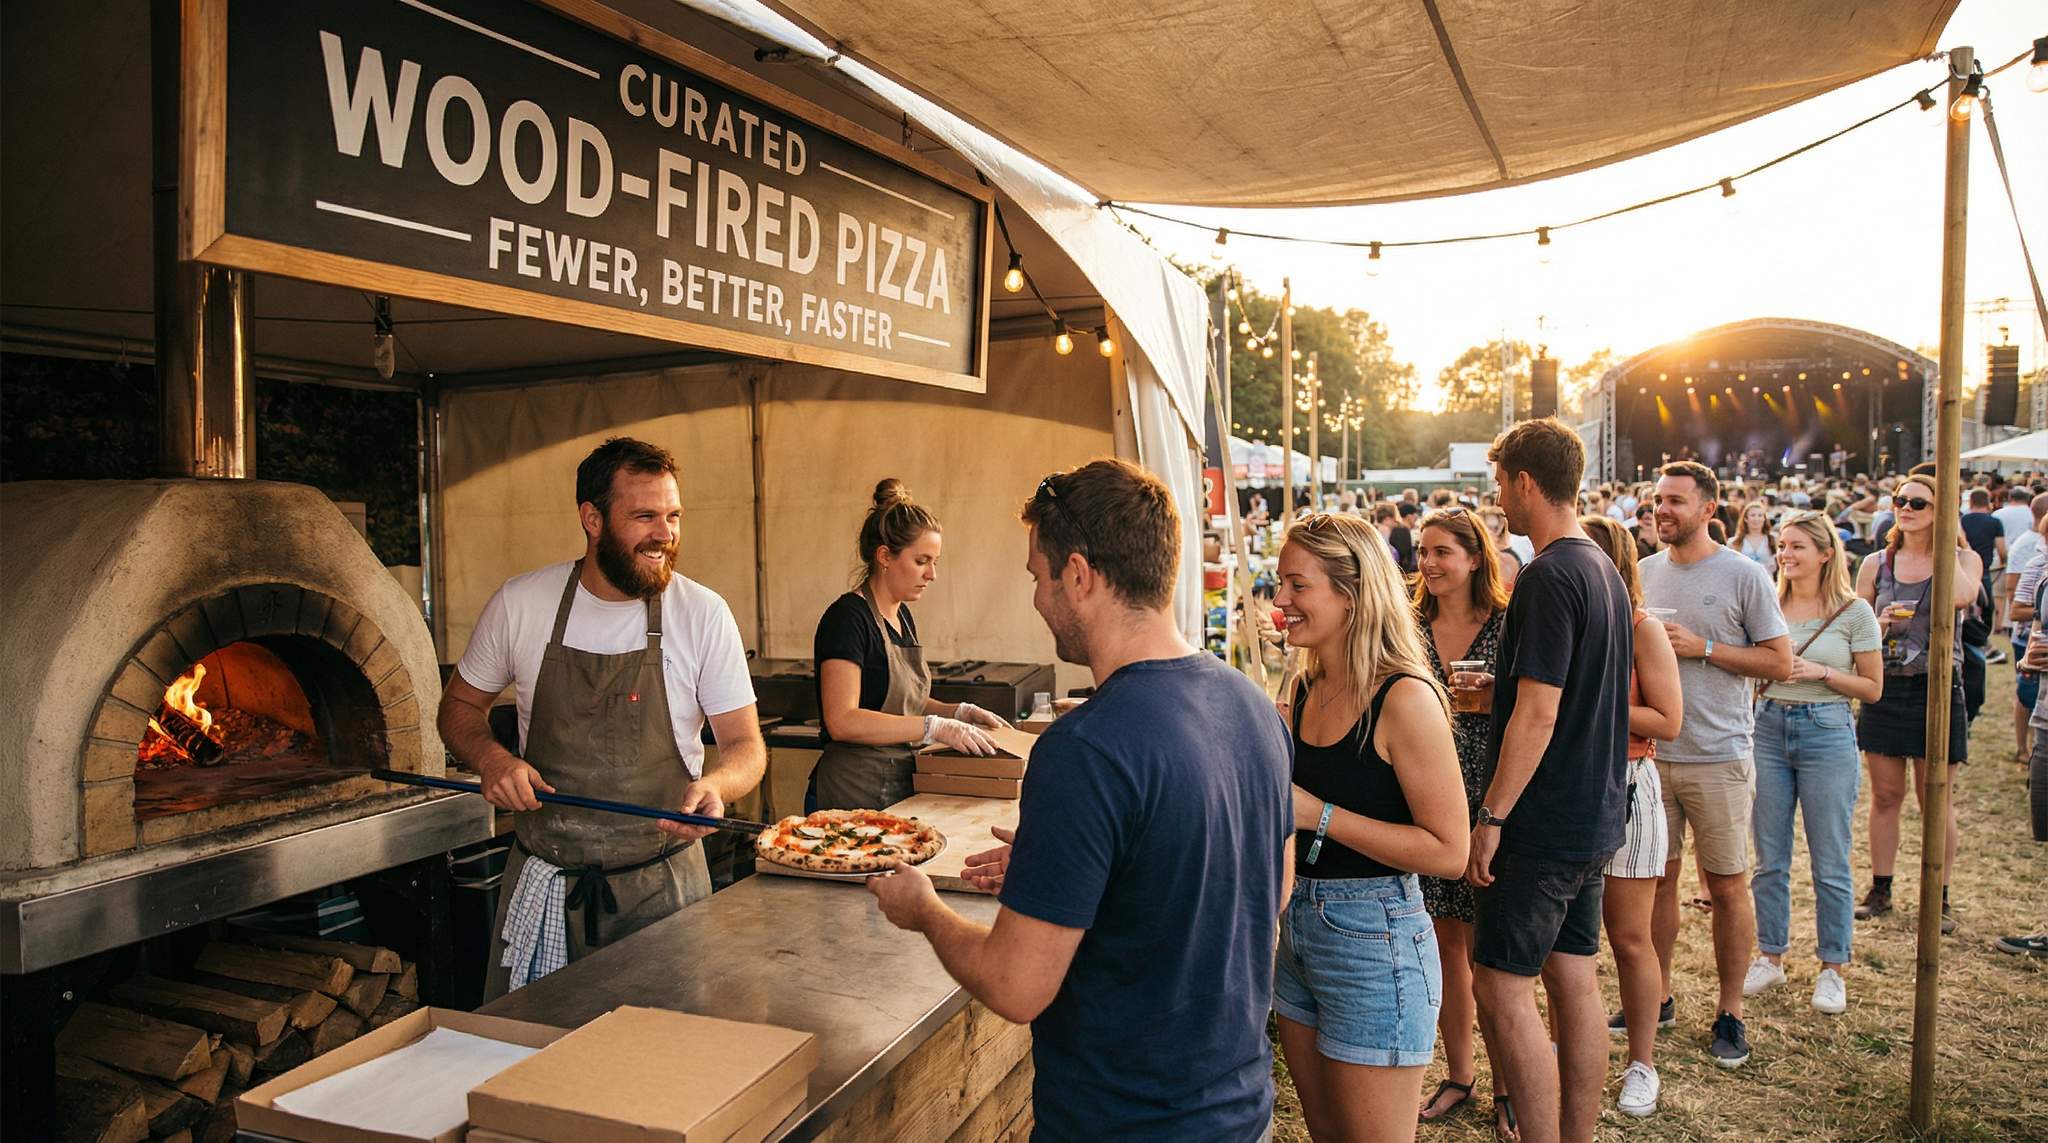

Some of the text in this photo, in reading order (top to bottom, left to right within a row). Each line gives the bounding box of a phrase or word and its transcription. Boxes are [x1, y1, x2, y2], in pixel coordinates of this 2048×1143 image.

[320, 30, 951, 315] WOOD-FIRED PIZZA
[620, 64, 806, 176] CURATED
[489, 217, 893, 350] FEWER, BETTER, FASTER
